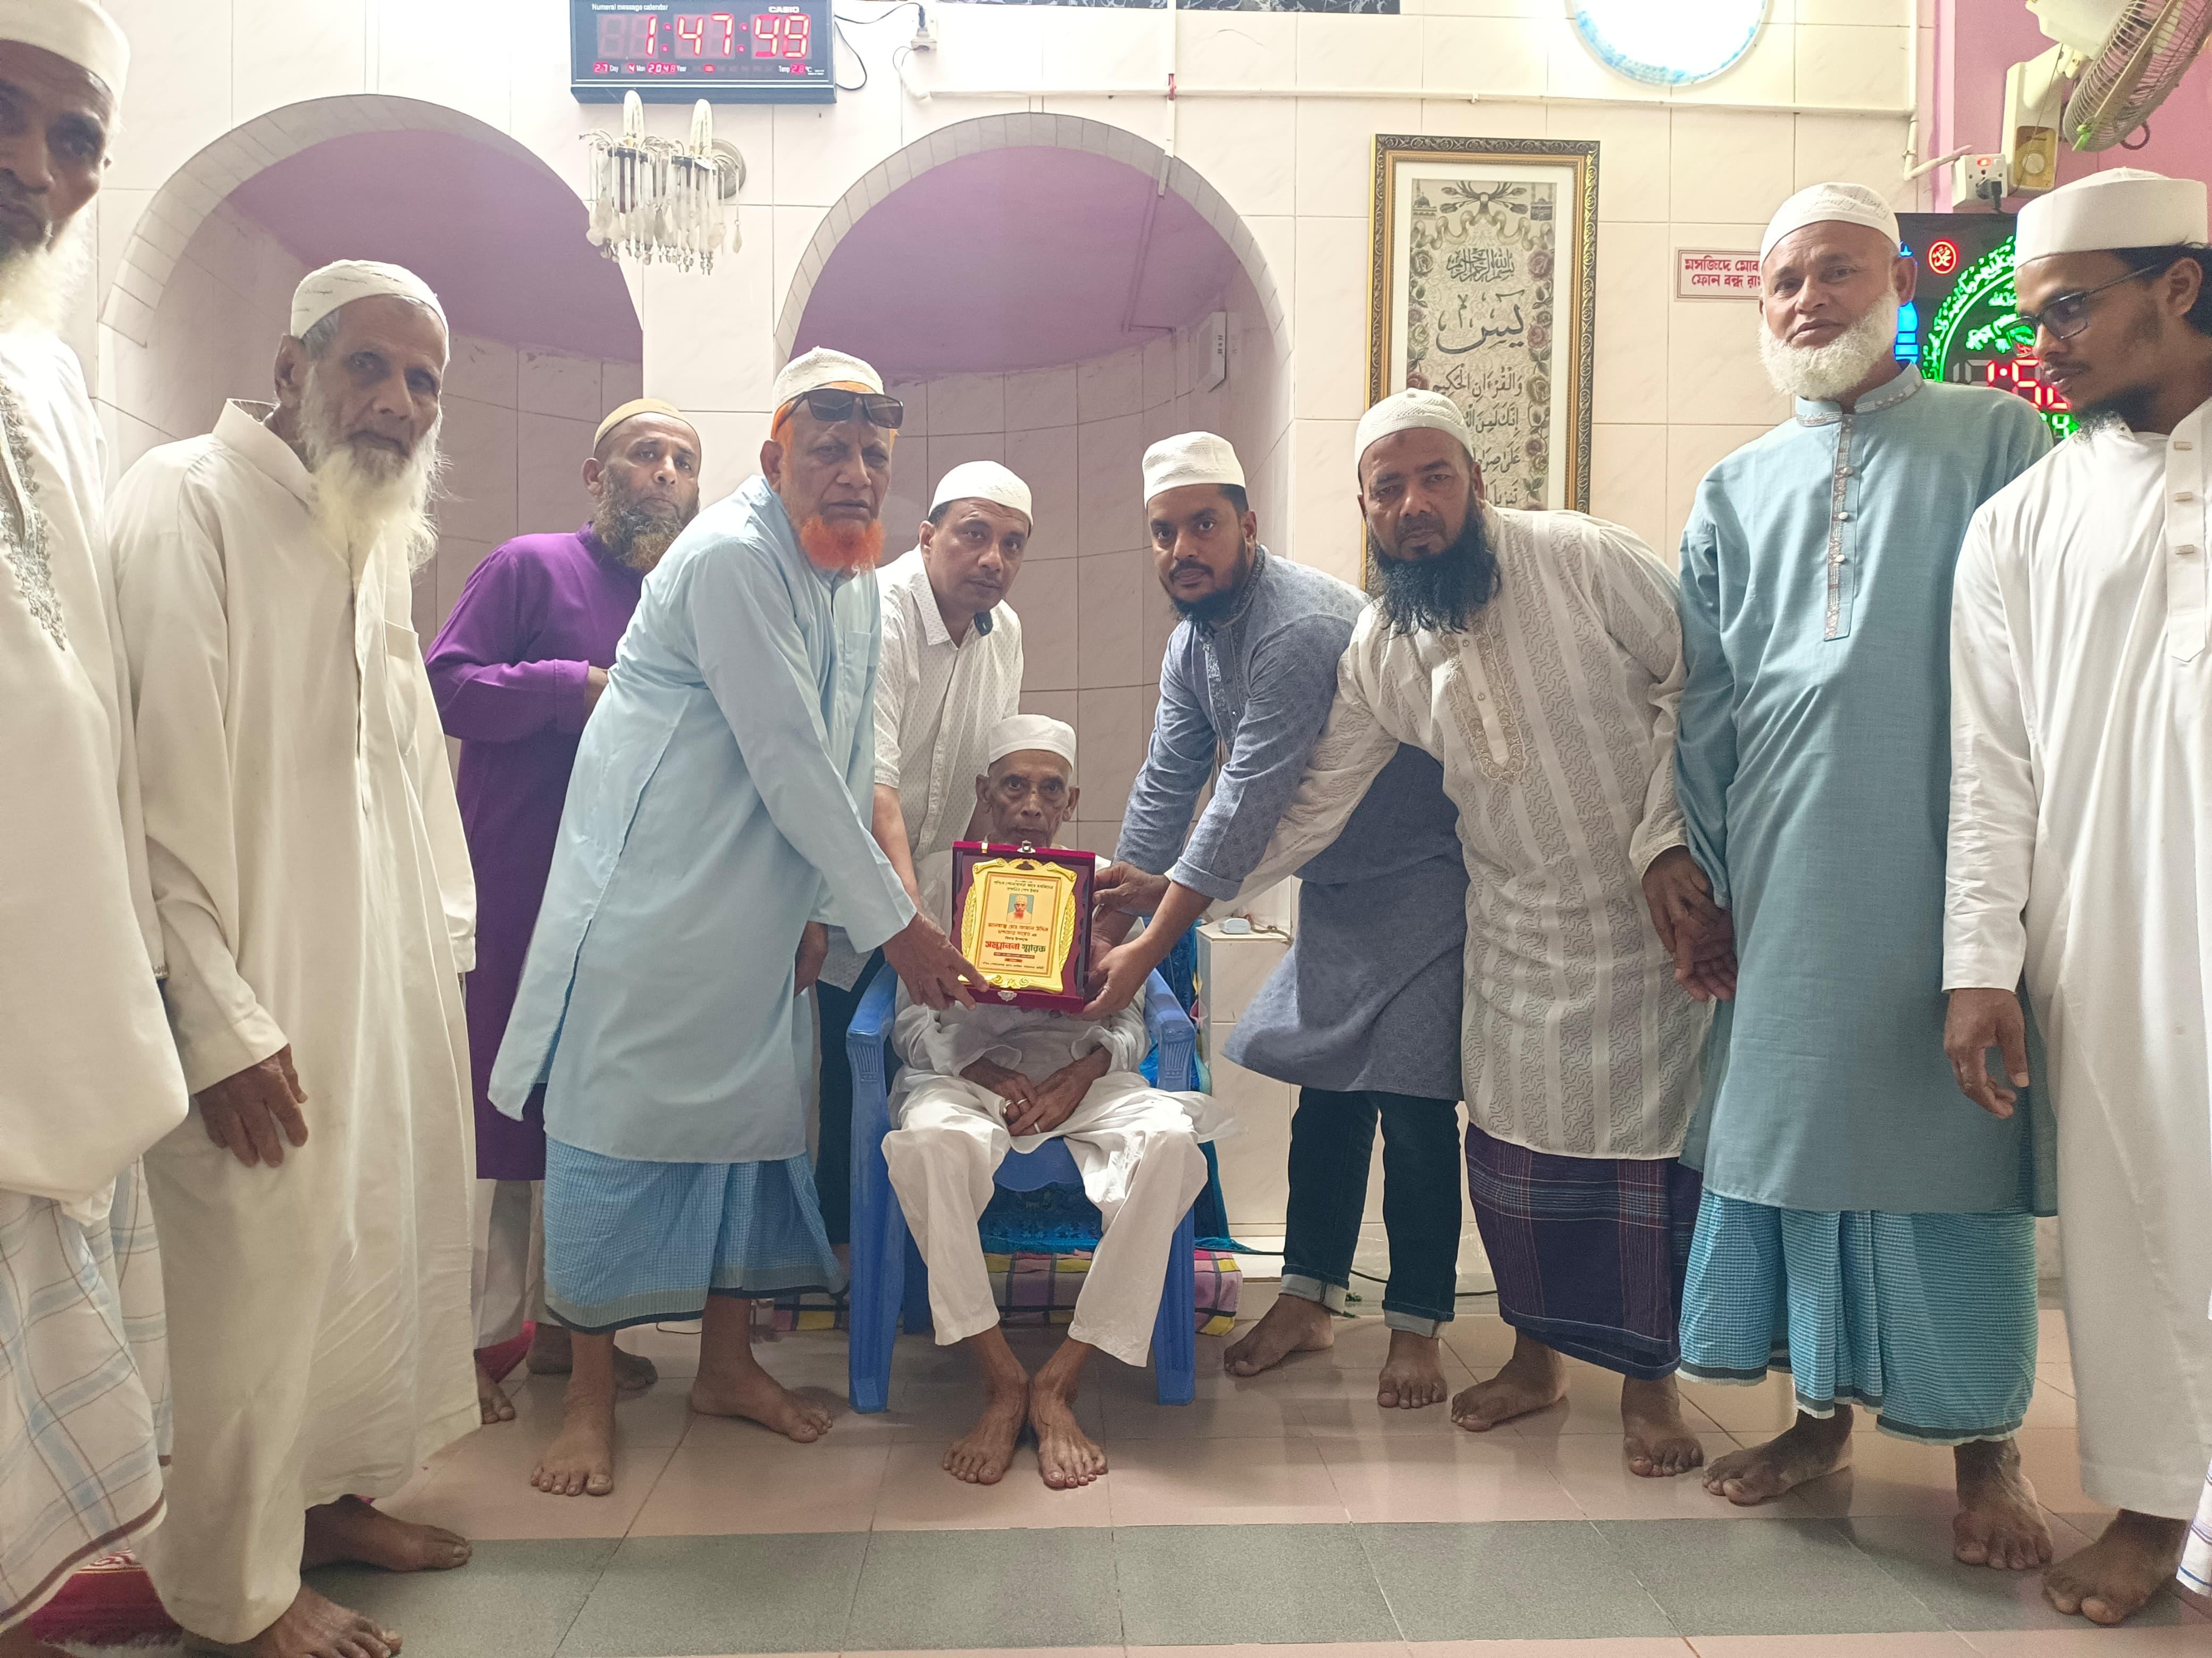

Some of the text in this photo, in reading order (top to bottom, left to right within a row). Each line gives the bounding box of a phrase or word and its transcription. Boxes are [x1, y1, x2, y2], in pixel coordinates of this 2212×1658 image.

[1685, 255, 1760, 272] মসজিদে মোব
[1691, 274, 1721, 287] ফোন
[1724, 275, 1744, 288] বন্ধ
[985, 941, 1046, 953] সম্মাননা স্মারক
